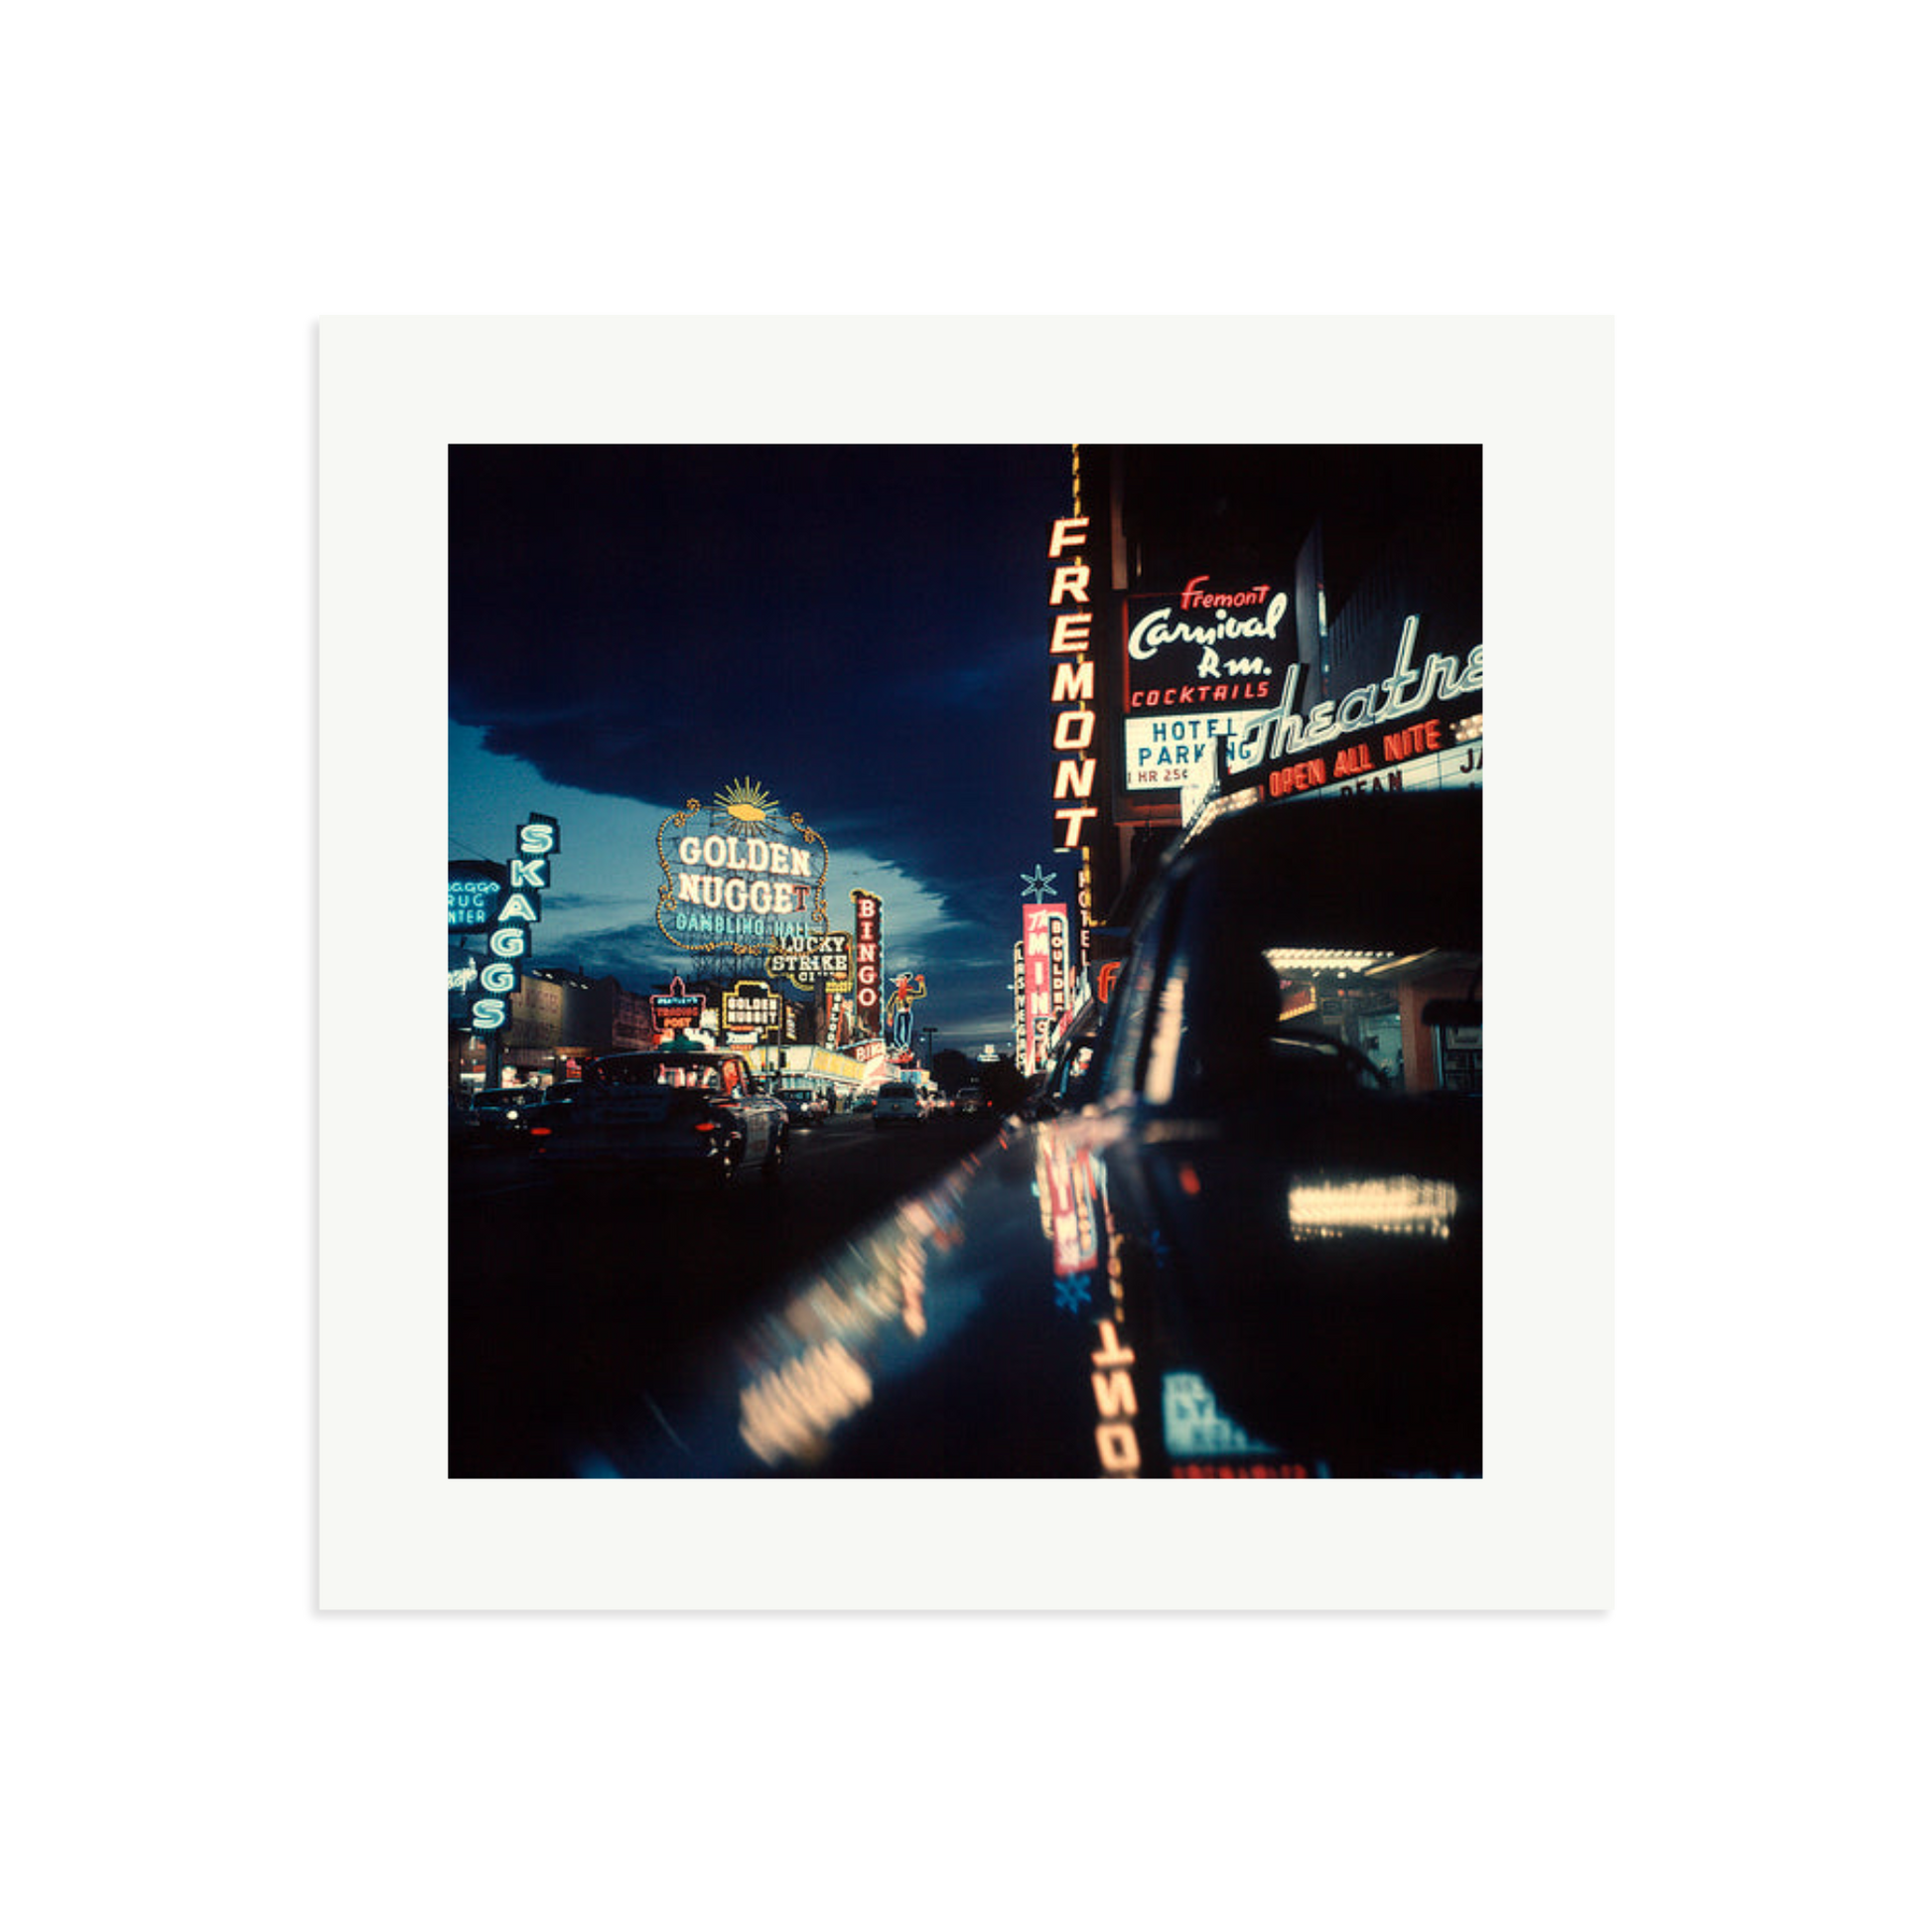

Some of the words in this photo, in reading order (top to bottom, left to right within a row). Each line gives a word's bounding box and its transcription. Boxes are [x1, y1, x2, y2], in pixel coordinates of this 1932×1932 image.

[1128, 593, 1288, 659] Carnival
[1048, 517, 1098, 847] FREMONT
[1132, 681, 1270, 708] COCKTAILS
[1153, 717, 1238, 742] HOTEL
[1138, 742, 1251, 766] PARKNG
[1269, 759, 1326, 798] OPEN
[1333, 744, 1375, 777] ALL
[1382, 720, 1443, 761] NITE
[1138, 770, 1159, 782] HR
[678, 835, 812, 877] GOLDEN
[677, 873, 811, 914] NUGGET
[472, 824, 554, 1030] SKAGGS
[676, 913, 763, 935] GAMBLING
[780, 936, 846, 952] LUCKY
[771, 954, 848, 971] STRIKE
[858, 898, 877, 1006] BINGO
[1028, 932, 1049, 1015] MIN
